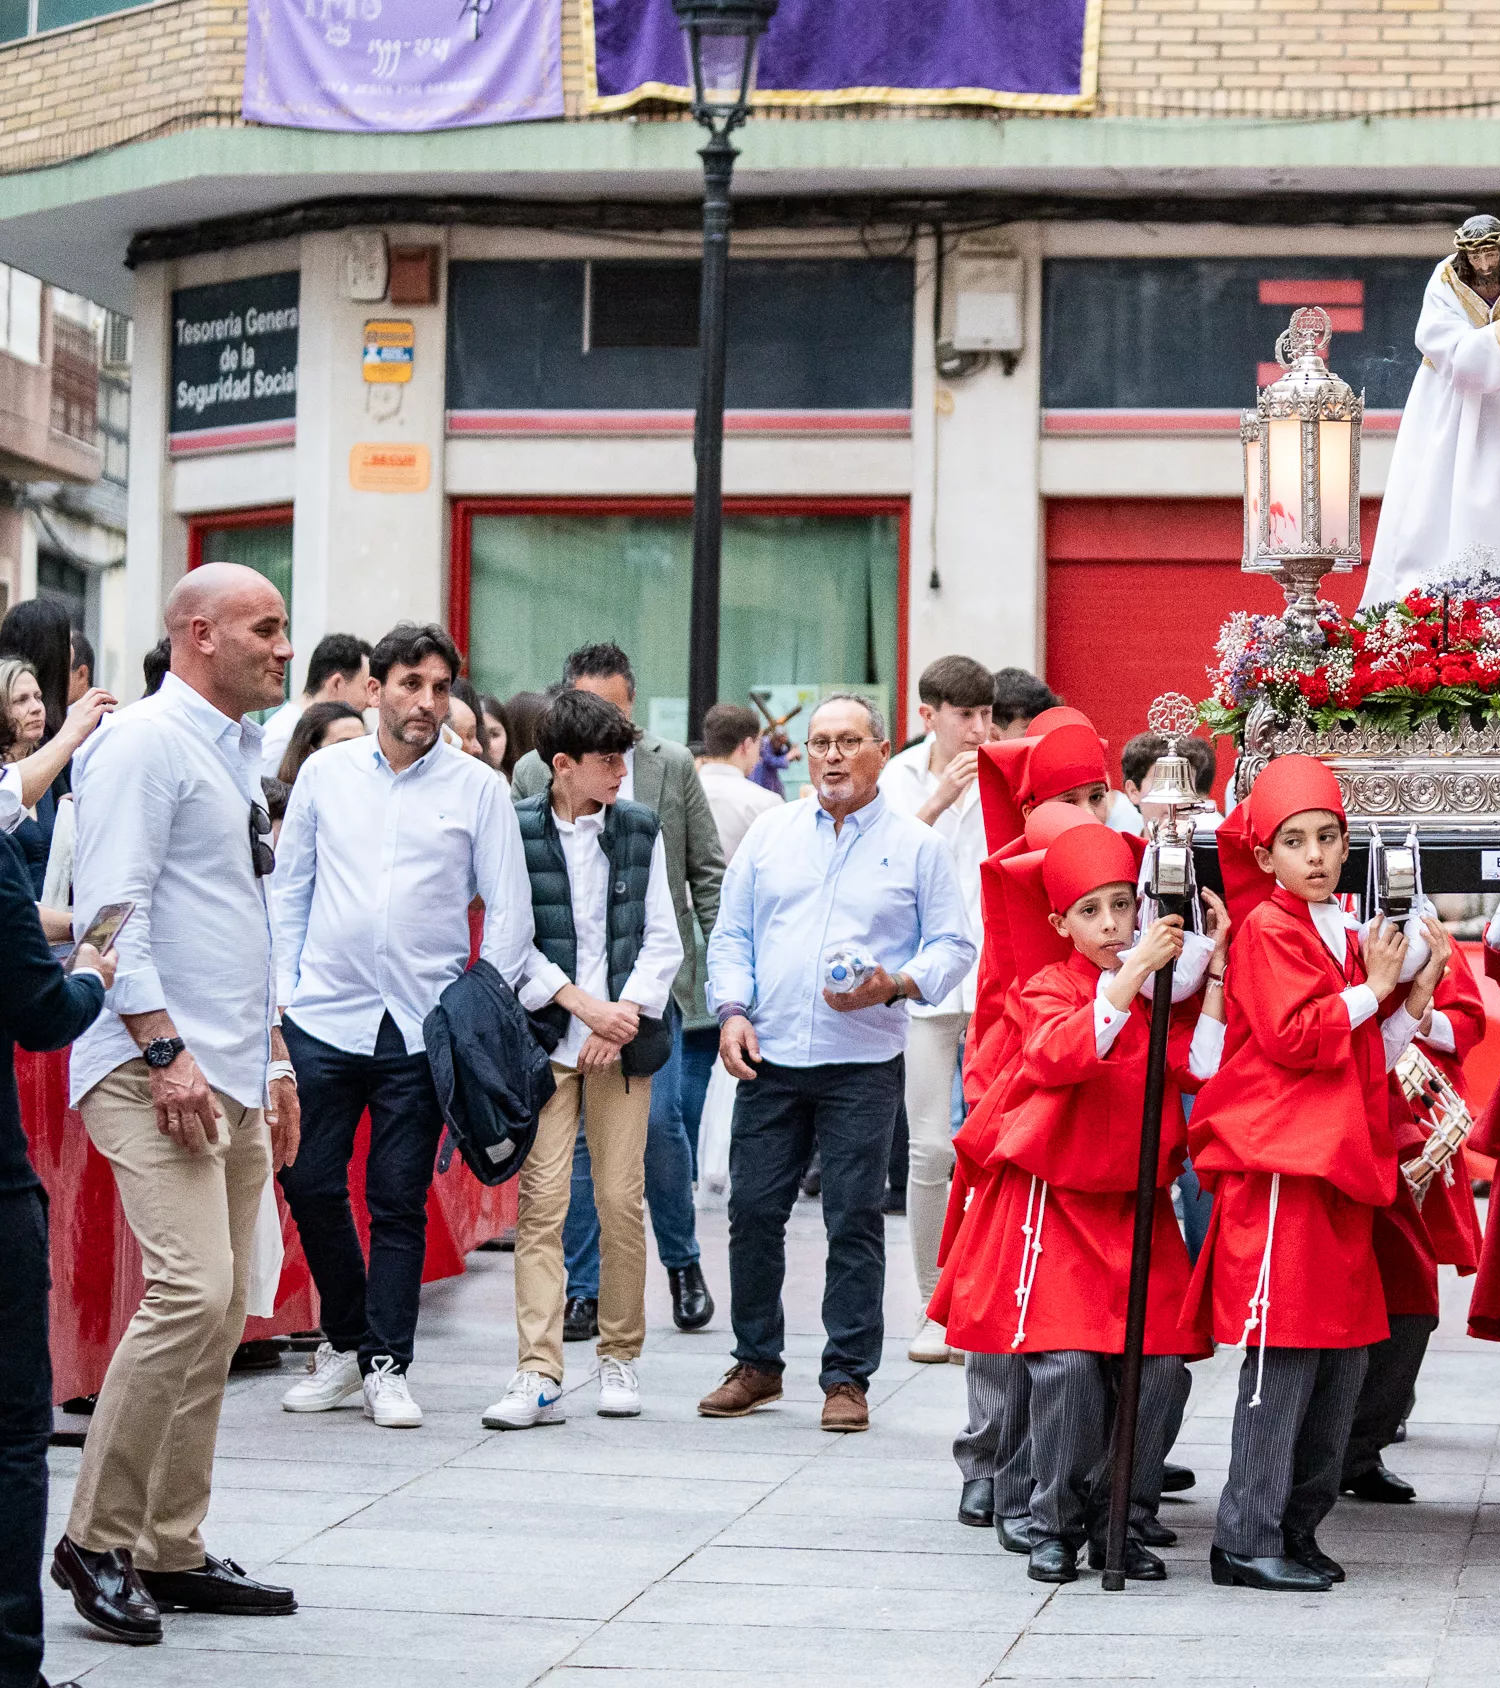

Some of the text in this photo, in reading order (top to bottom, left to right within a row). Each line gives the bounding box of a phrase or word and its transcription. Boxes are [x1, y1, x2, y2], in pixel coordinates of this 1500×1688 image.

[220, 342, 255, 372] de la
[176, 371, 251, 414] Seguridad
